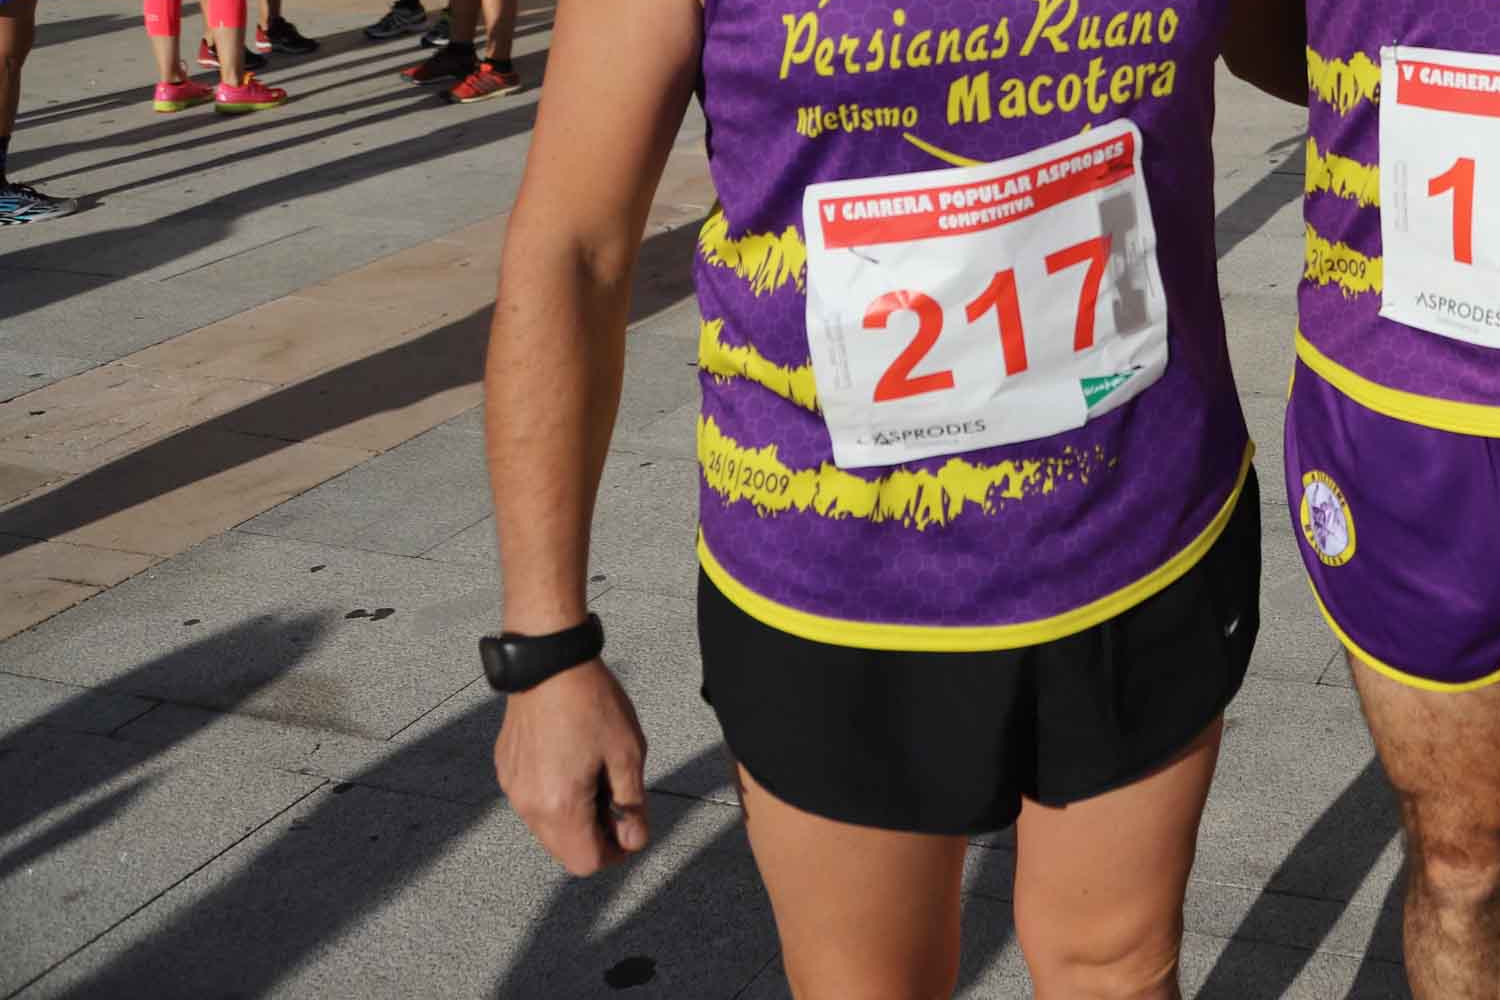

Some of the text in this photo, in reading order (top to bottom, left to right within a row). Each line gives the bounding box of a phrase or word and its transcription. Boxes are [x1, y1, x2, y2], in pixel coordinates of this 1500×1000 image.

[779, 8, 1010, 80] Persianas
[1402, 65, 1415, 81] V
[946, 56, 1176, 126] Macotera
[823, 142, 1125, 223] V CARRERA POPULAR ASPRODES
[938, 196, 1035, 231] COMPETITIVA
[860, 236, 1113, 404] 217
[872, 418, 987, 446] ASPRODES
